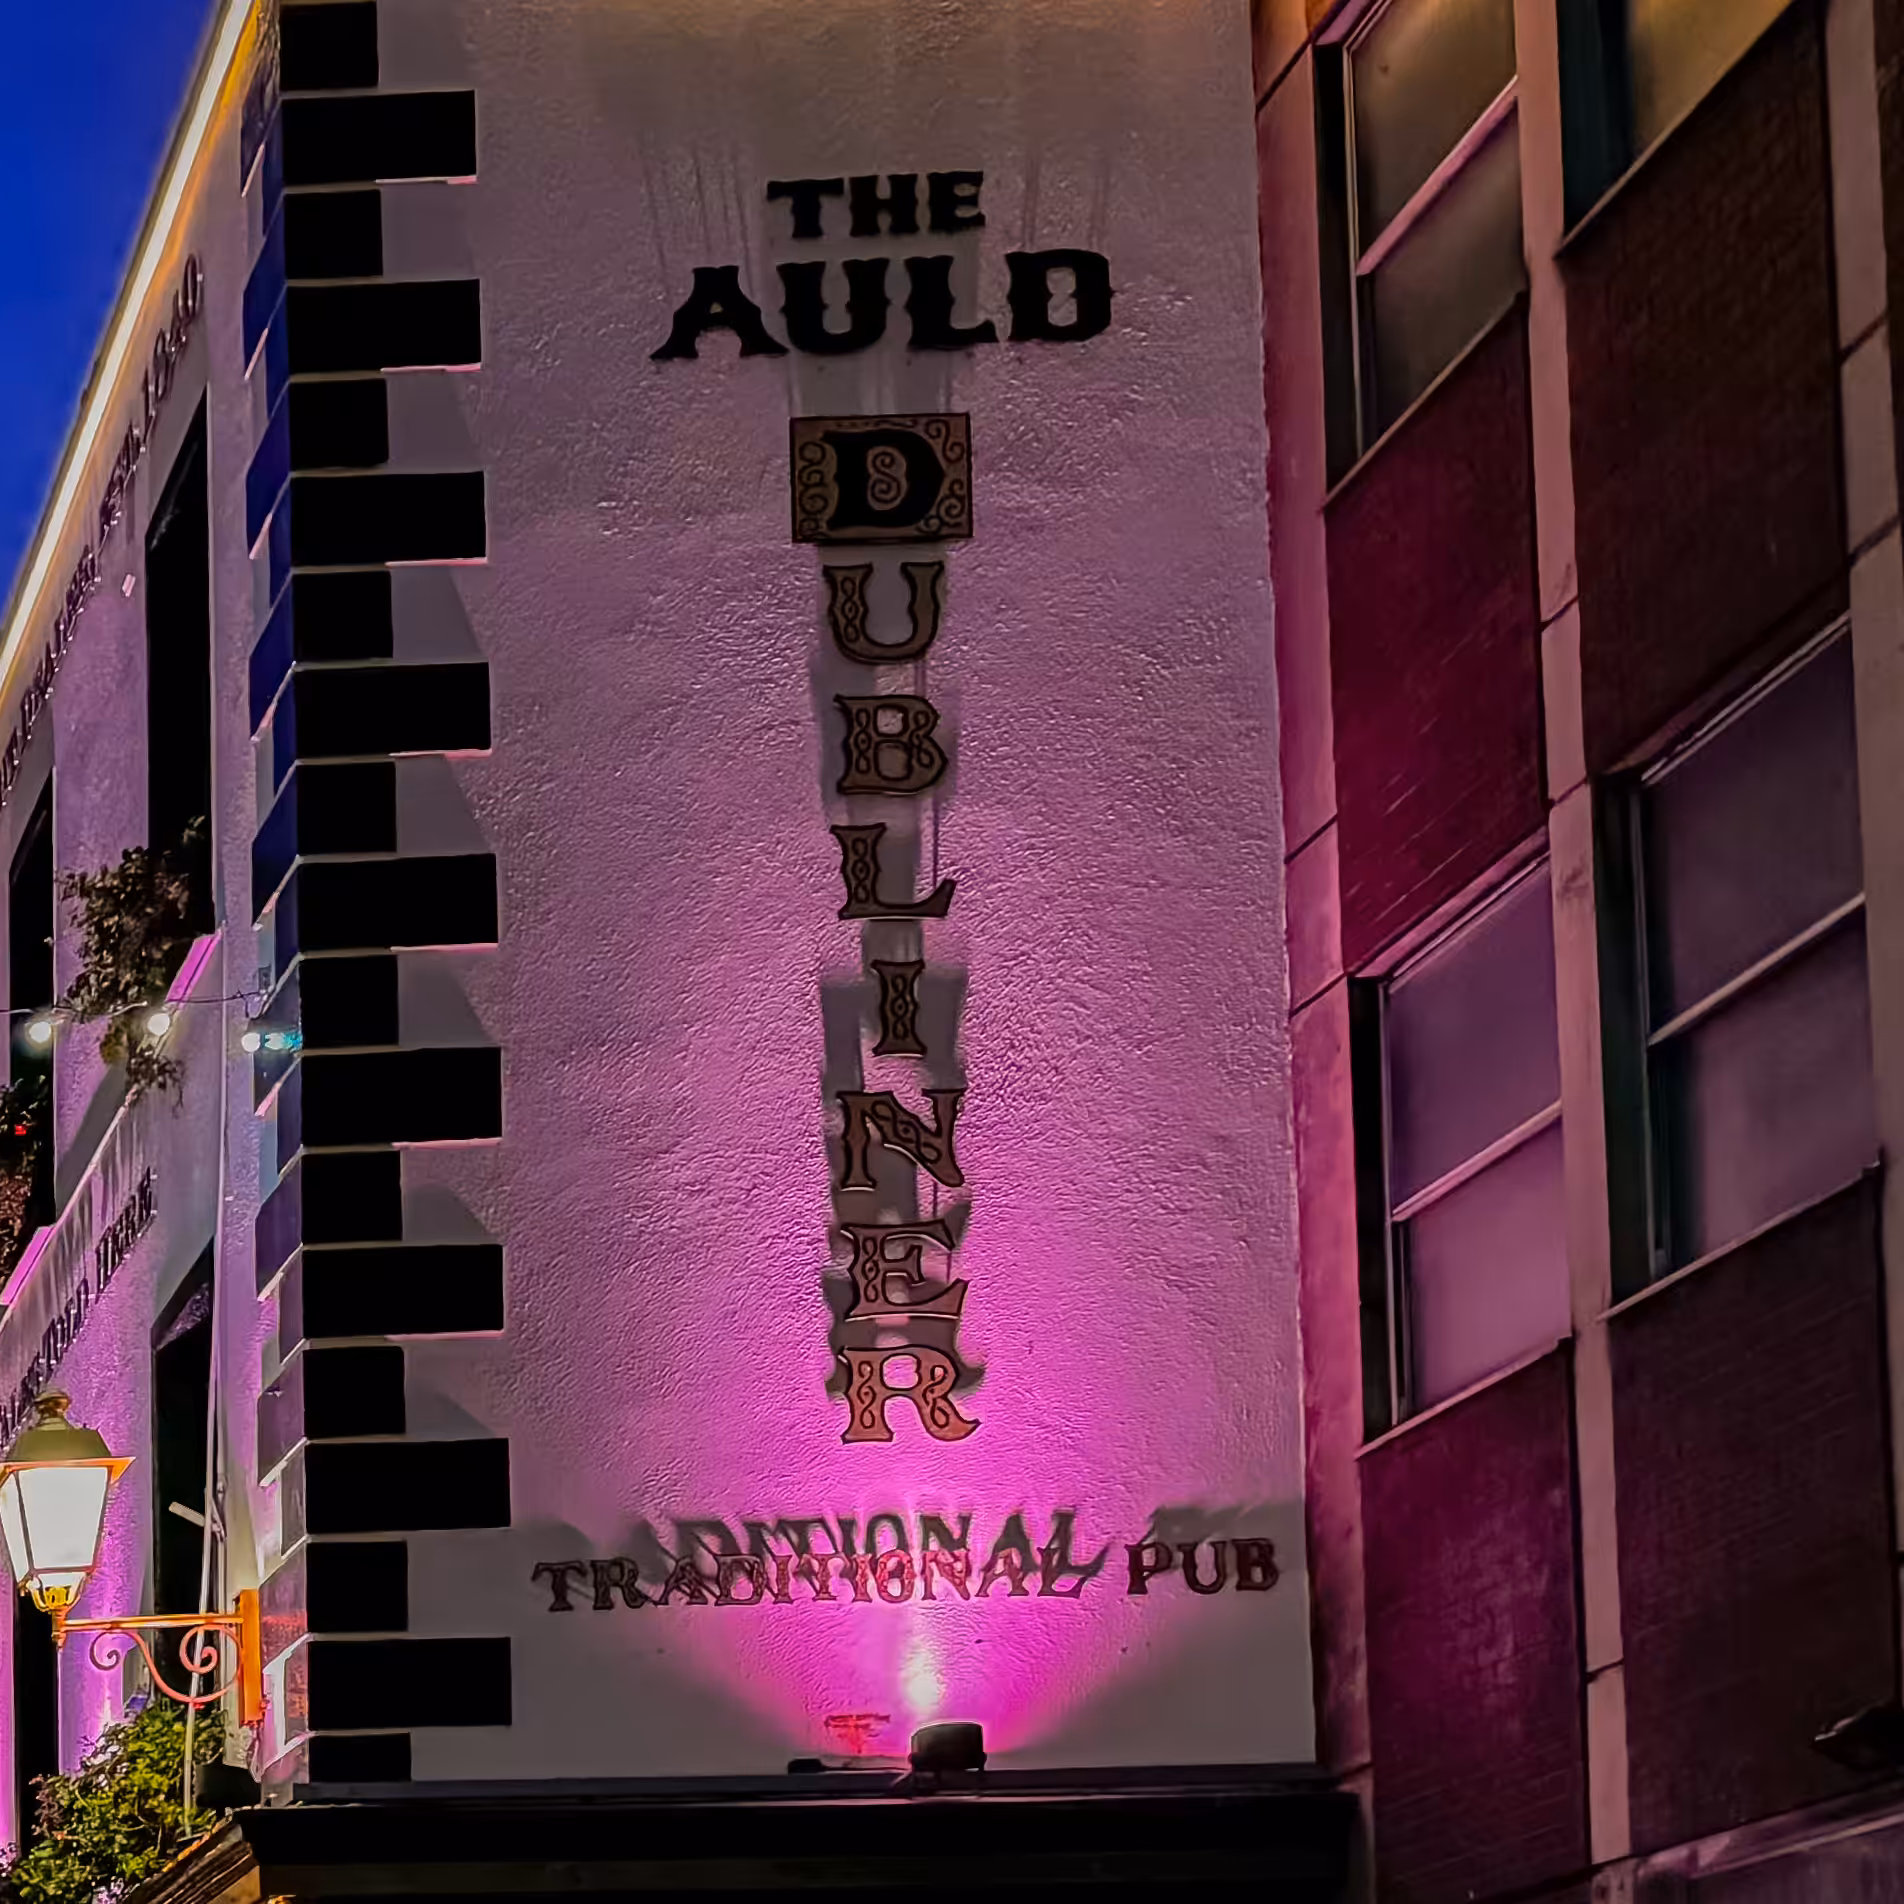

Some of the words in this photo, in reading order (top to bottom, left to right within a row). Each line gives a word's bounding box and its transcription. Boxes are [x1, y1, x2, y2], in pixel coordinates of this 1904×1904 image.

[767, 170, 985, 240] THE
[650, 247, 1113, 360] AULD
[817, 418, 980, 1445] DUBLINER
[530, 1545, 1093, 1614] TRADITIONAL
[1125, 1537, 1281, 1597] PUB
